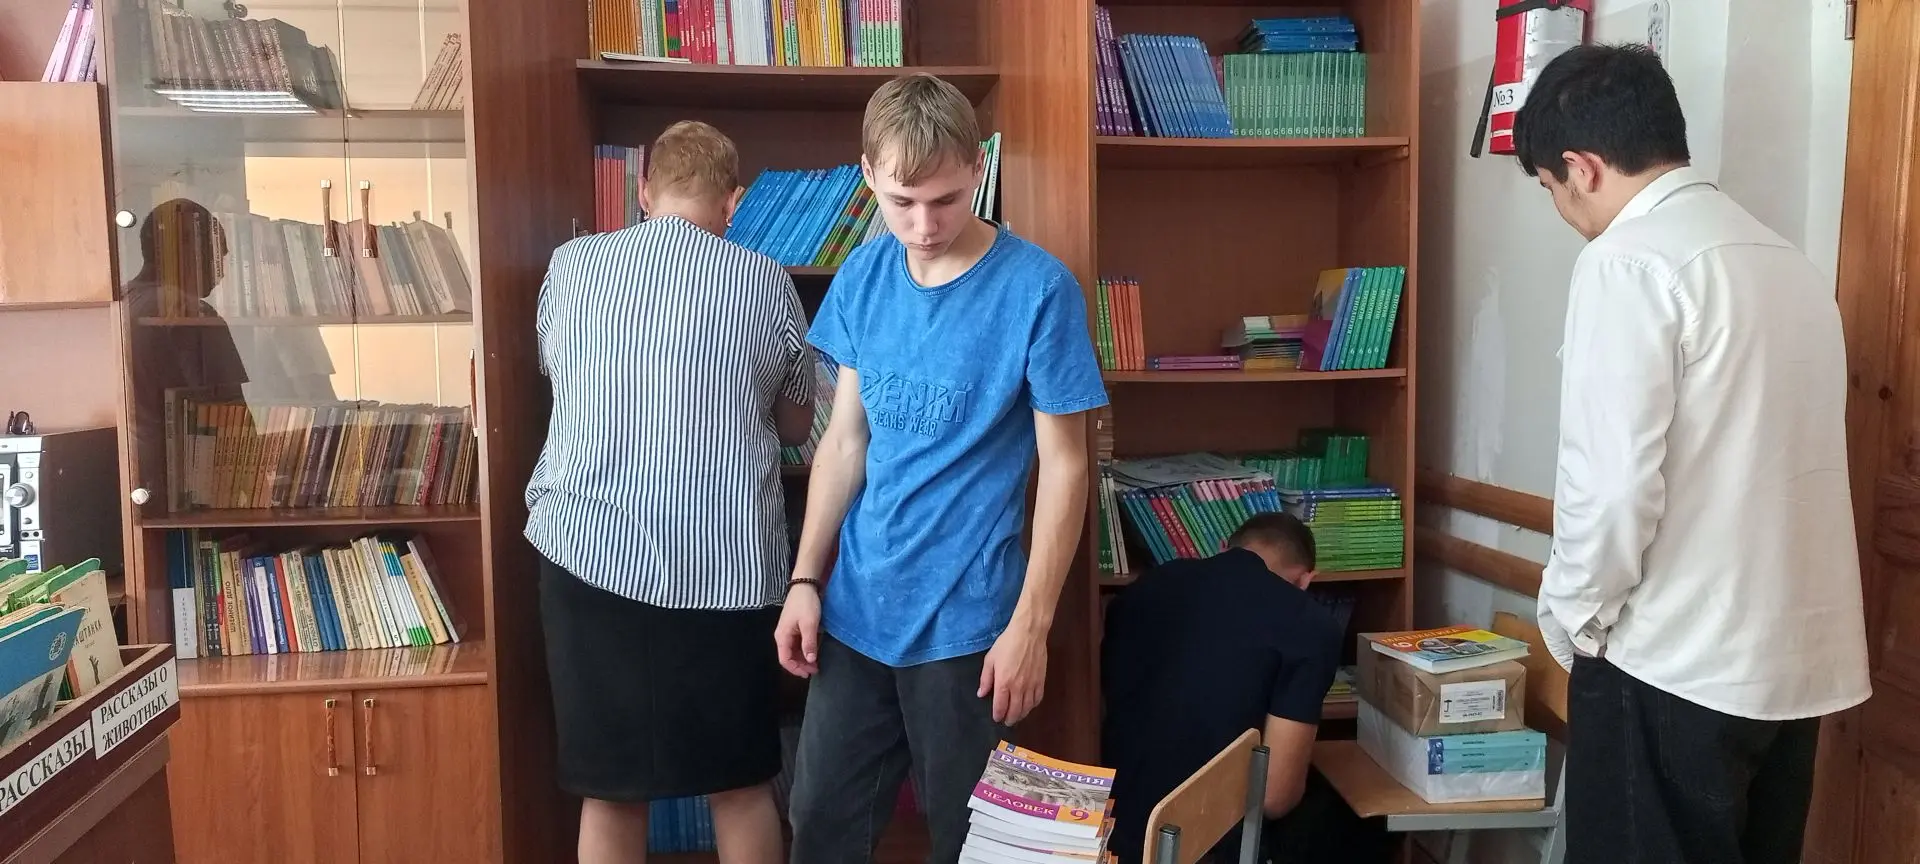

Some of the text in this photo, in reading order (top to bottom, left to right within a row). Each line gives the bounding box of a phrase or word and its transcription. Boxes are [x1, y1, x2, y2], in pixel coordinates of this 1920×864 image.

[1493, 88, 1514, 107] №3
[1347, 296, 1361, 336] БИОЛОГИЯ
[1387, 294, 1400, 333] БИОЛОГИЯ
[872, 409, 938, 438] JEANS WEAR
[225, 580, 233, 599] ДЕЛО
[75, 619, 103, 646] АШТАНКА
[100, 666, 168, 725] РАССКАЗЫ О
[102, 688, 169, 753] ЖИВОТНЫХ
[0, 729, 88, 812] РАССКАЗЫ
[999, 753, 1106, 786] БИОЛОГИЯ
[983, 789, 1090, 821] ЧЕЛОВЕК 9
